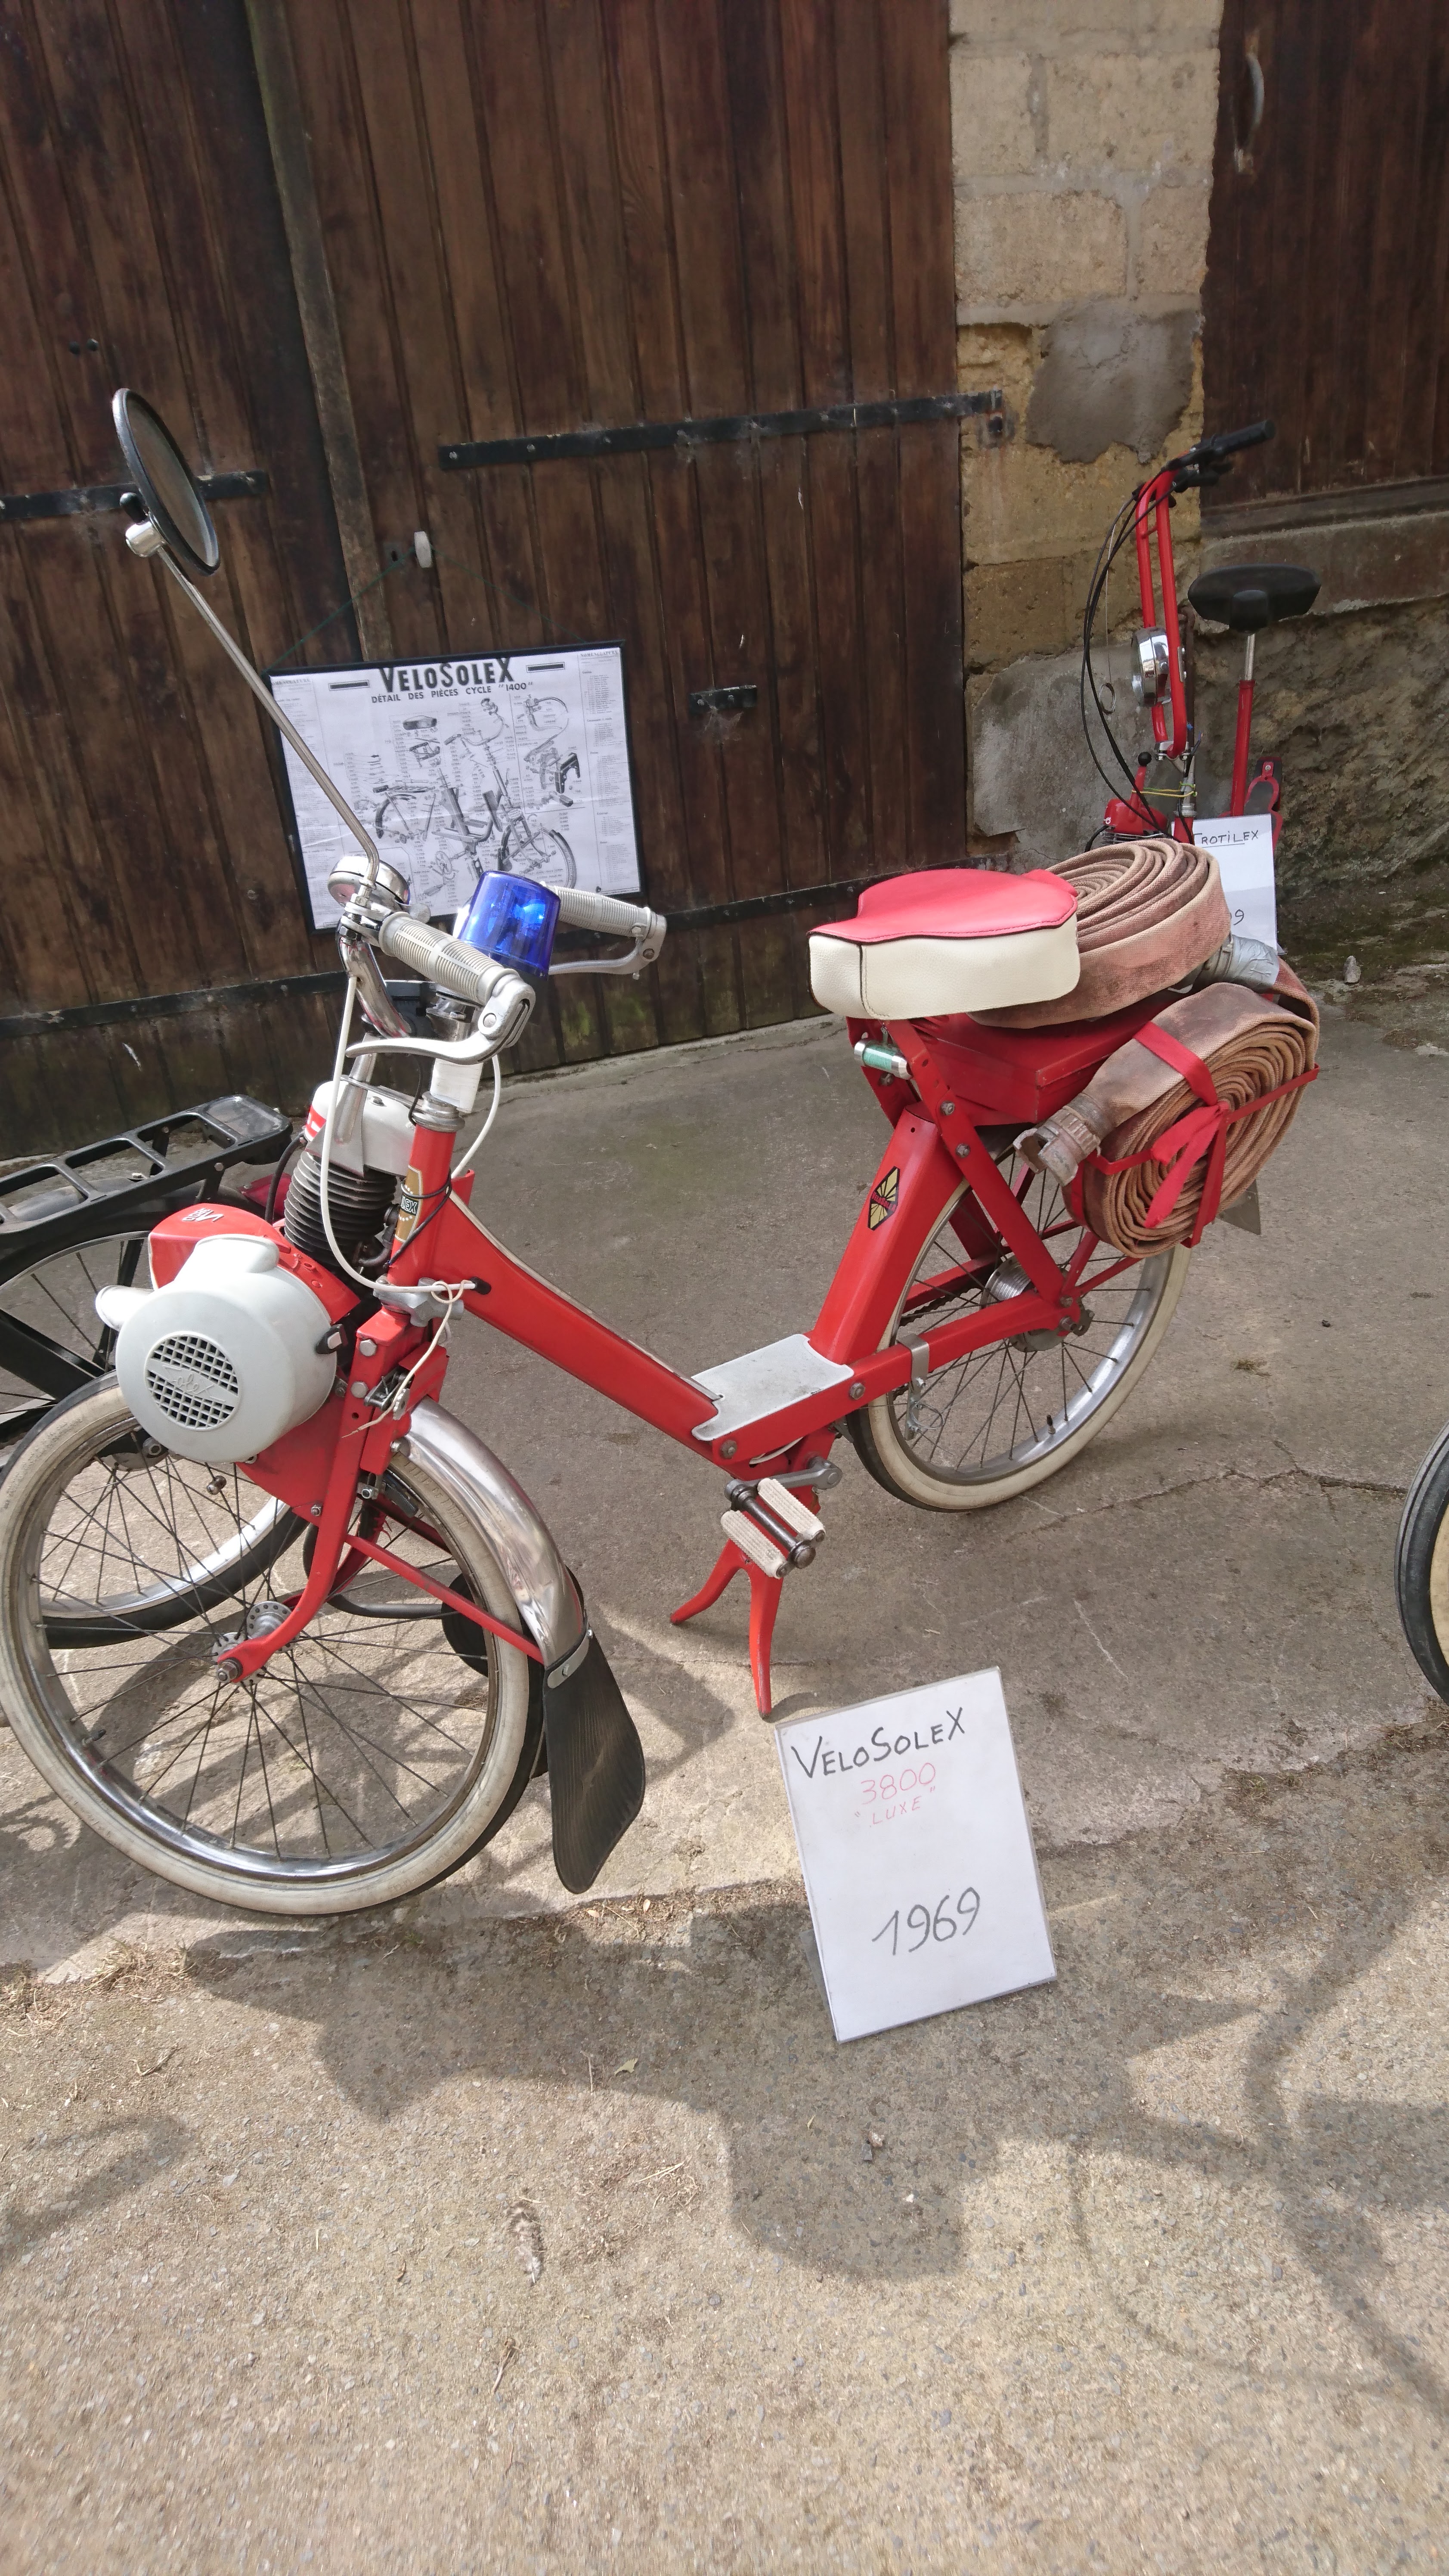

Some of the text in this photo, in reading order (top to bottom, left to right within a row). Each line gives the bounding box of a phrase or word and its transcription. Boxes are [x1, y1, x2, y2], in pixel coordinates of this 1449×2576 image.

[372, 694, 400, 703] DÉTAIL
[431, 688, 458, 698] PIÈCES
[465, 686, 492, 695] CYCLE
[379, 658, 514, 693] VELOSOLEX
[791, 1707, 966, 1778] VELOSOLEX
[860, 1762, 936, 1805] 3800
[871, 1886, 981, 1956] 1969
